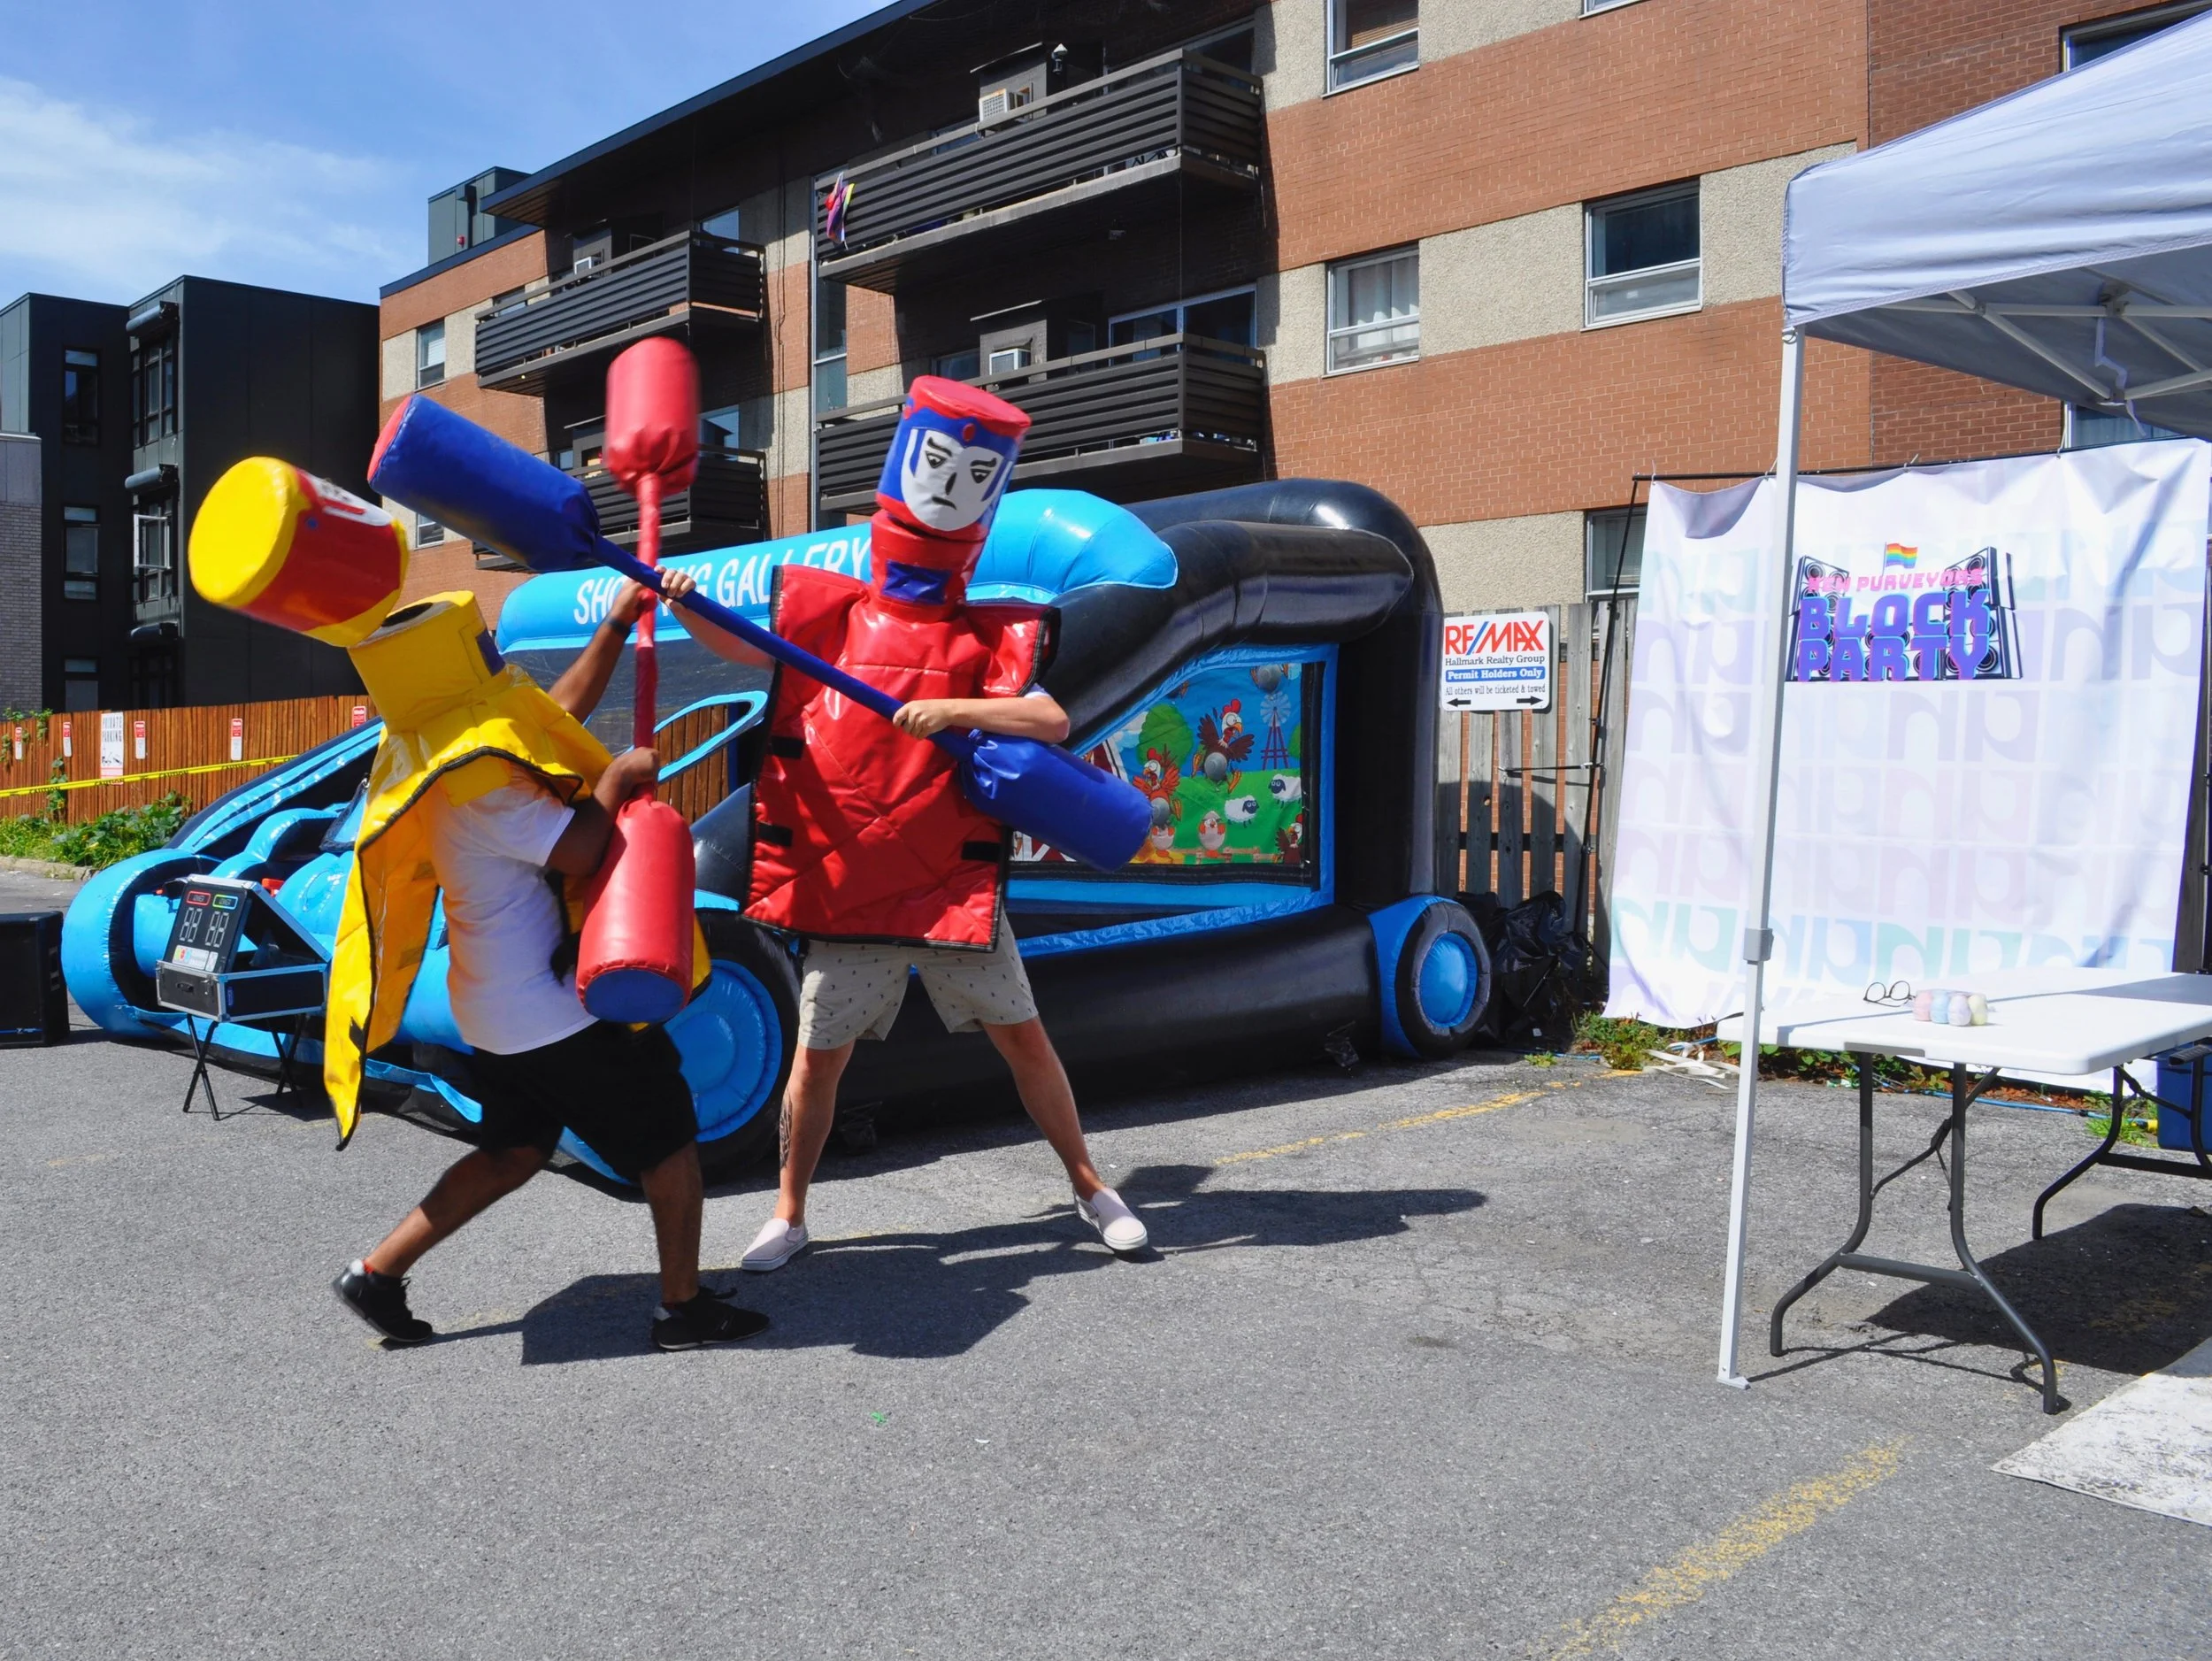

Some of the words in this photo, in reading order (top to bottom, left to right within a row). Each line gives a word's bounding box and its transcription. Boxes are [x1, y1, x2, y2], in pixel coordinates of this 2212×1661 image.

[1800, 588, 1991, 637] BLOCK
[1446, 657, 1484, 665] Hallmark
[1486, 656, 1514, 666] Realty
[1517, 655, 1545, 665] Group
[1798, 634, 1990, 682] PARTY
[1448, 670, 1479, 681] Permit
[1481, 669, 1517, 680] Holders
[1520, 667, 1543, 679] Only
[1455, 686, 1473, 695] others
[1475, 685, 1485, 695] will
[1486, 685, 1493, 694] be
[1495, 684, 1519, 694] ticketed
[1527, 683, 1546, 693] towed
